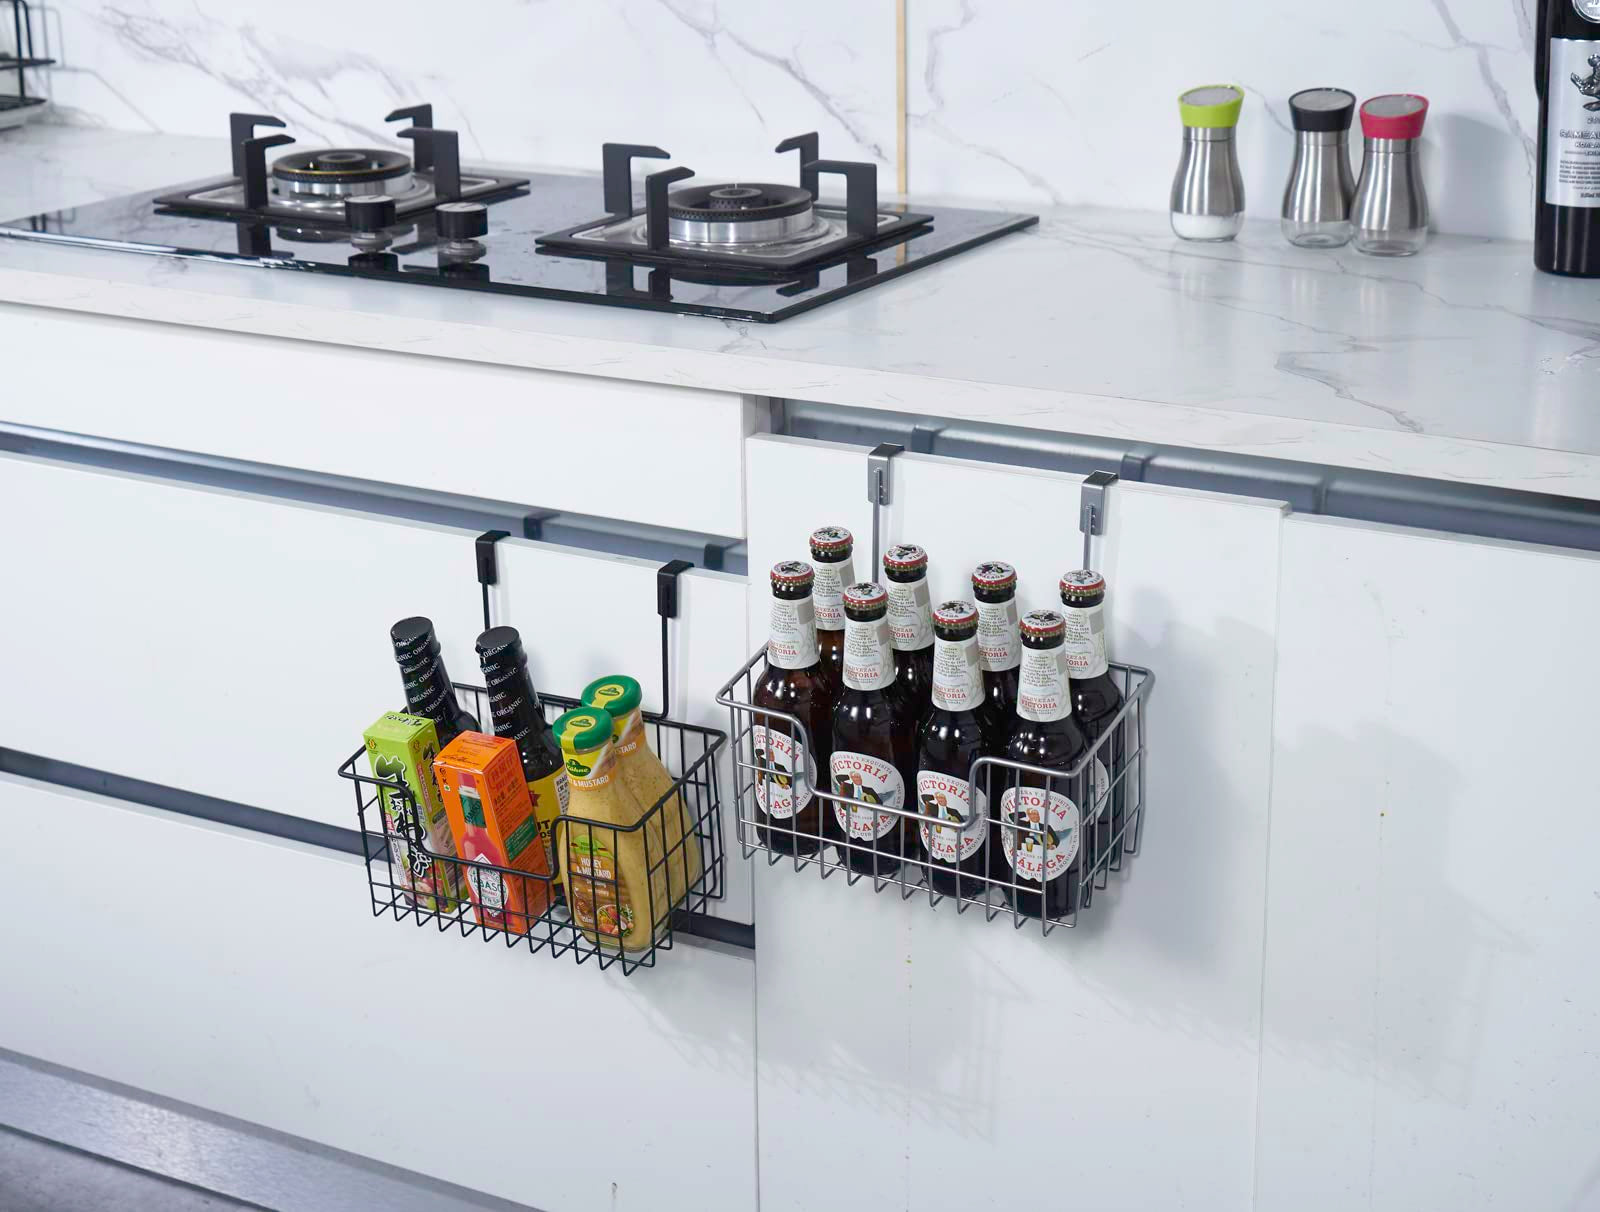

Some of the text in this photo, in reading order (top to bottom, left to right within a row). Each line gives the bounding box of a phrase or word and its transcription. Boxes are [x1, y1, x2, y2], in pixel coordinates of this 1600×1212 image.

[409, 685, 436, 704] ORGANIC
[496, 696, 524, 717] ORGANIC
[579, 775, 609, 788] MUSTARD
[832, 760, 889, 784] VICTORIA
